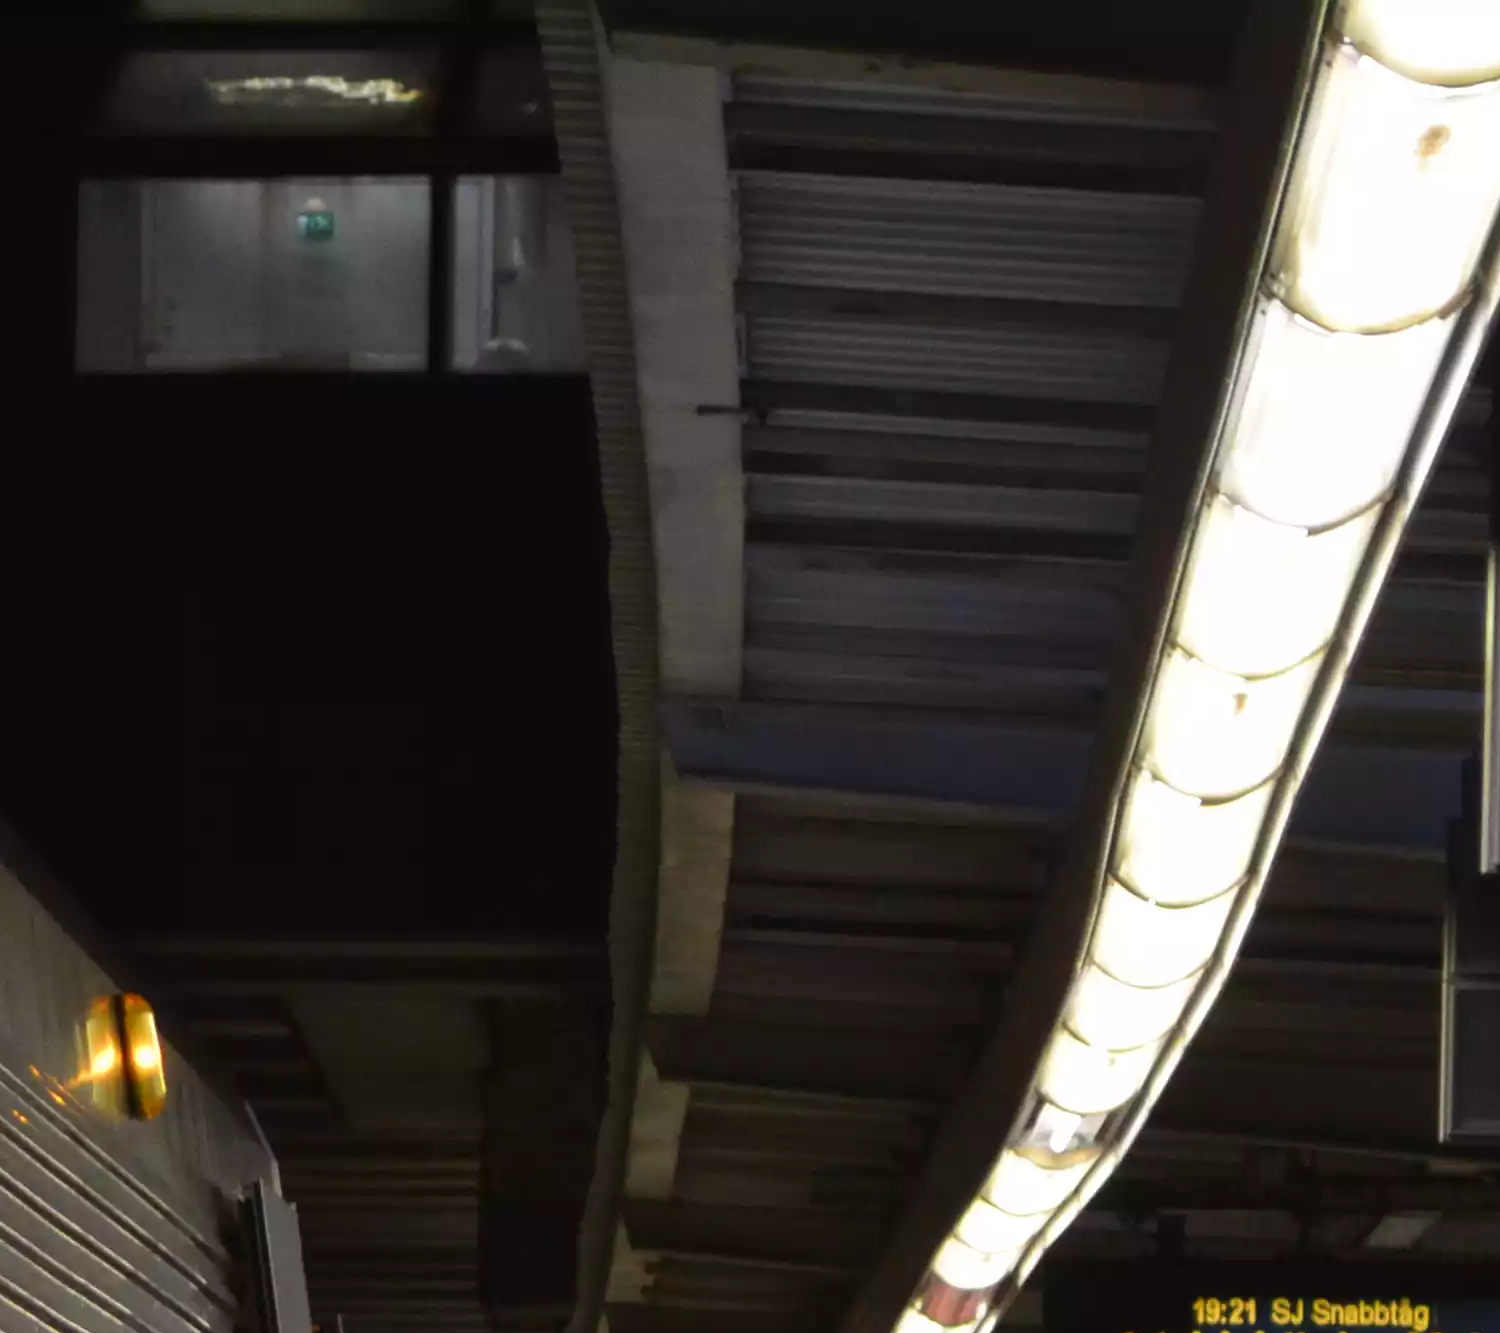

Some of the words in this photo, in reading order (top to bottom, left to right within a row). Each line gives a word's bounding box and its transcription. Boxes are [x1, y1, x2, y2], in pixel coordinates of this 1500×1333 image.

[1193, 1297, 1257, 1325] 19:21
[1271, 1297, 1304, 1325] SJ
[1311, 1298, 1430, 1331] Snabbtåg
